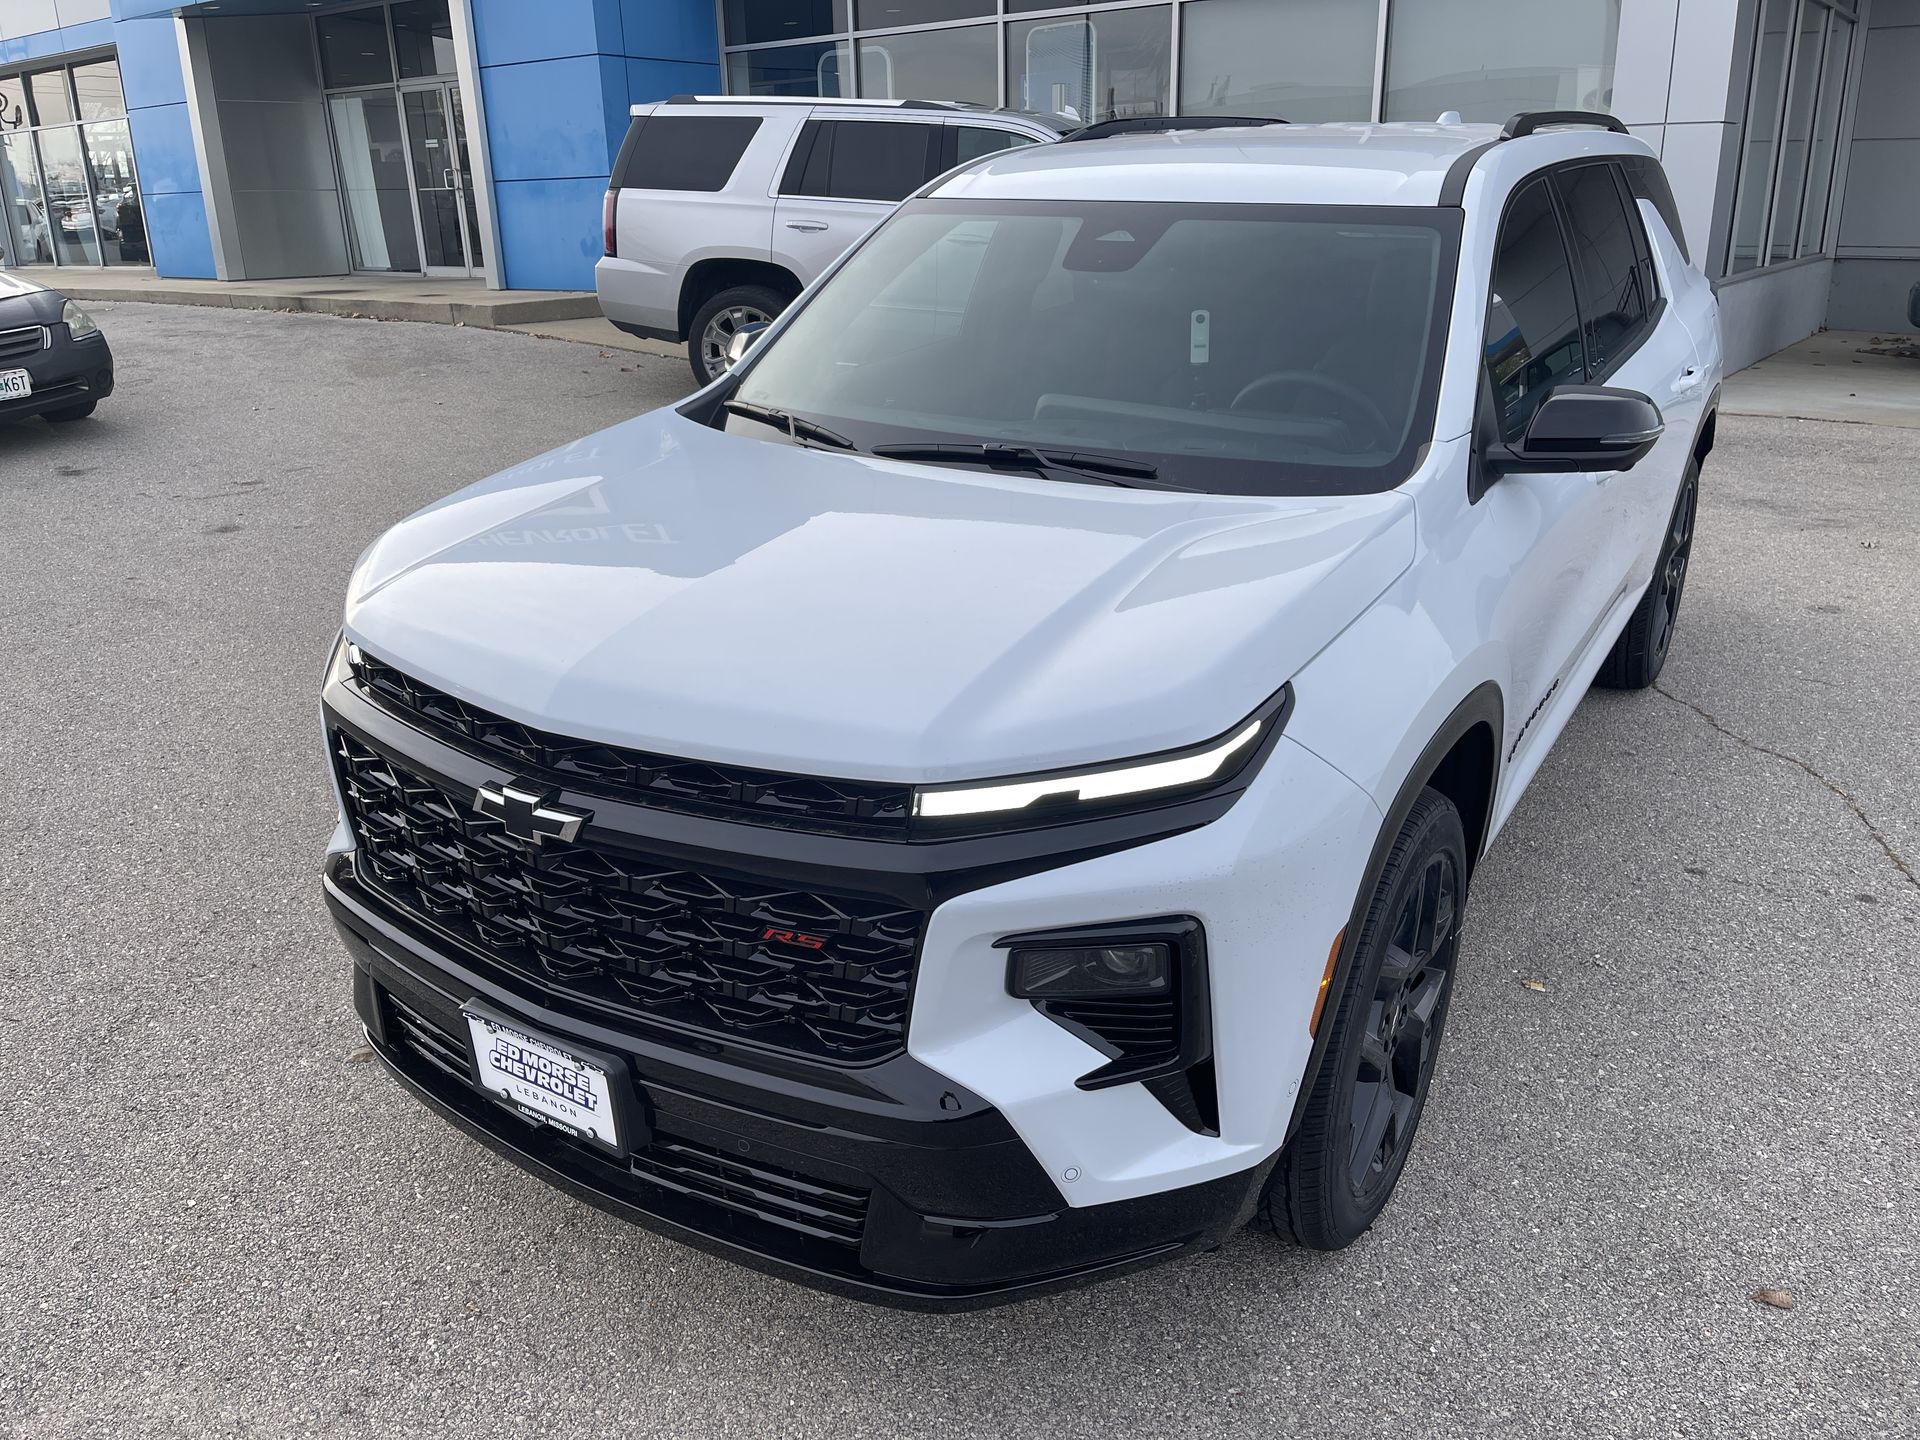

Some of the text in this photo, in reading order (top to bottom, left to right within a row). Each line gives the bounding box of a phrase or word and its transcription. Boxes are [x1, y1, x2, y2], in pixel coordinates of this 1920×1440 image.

[3, 375, 26, 392] K6T
[762, 928, 826, 949] RS
[491, 1022, 573, 1061] ED MORSE CHEVROLET
[489, 1050, 597, 1111] CHEVROLET
[496, 1038, 590, 1092] ED MORSE
[516, 1084, 577, 1118] LEBANON
[517, 1104, 578, 1137] LEBANON, MISSOURI
